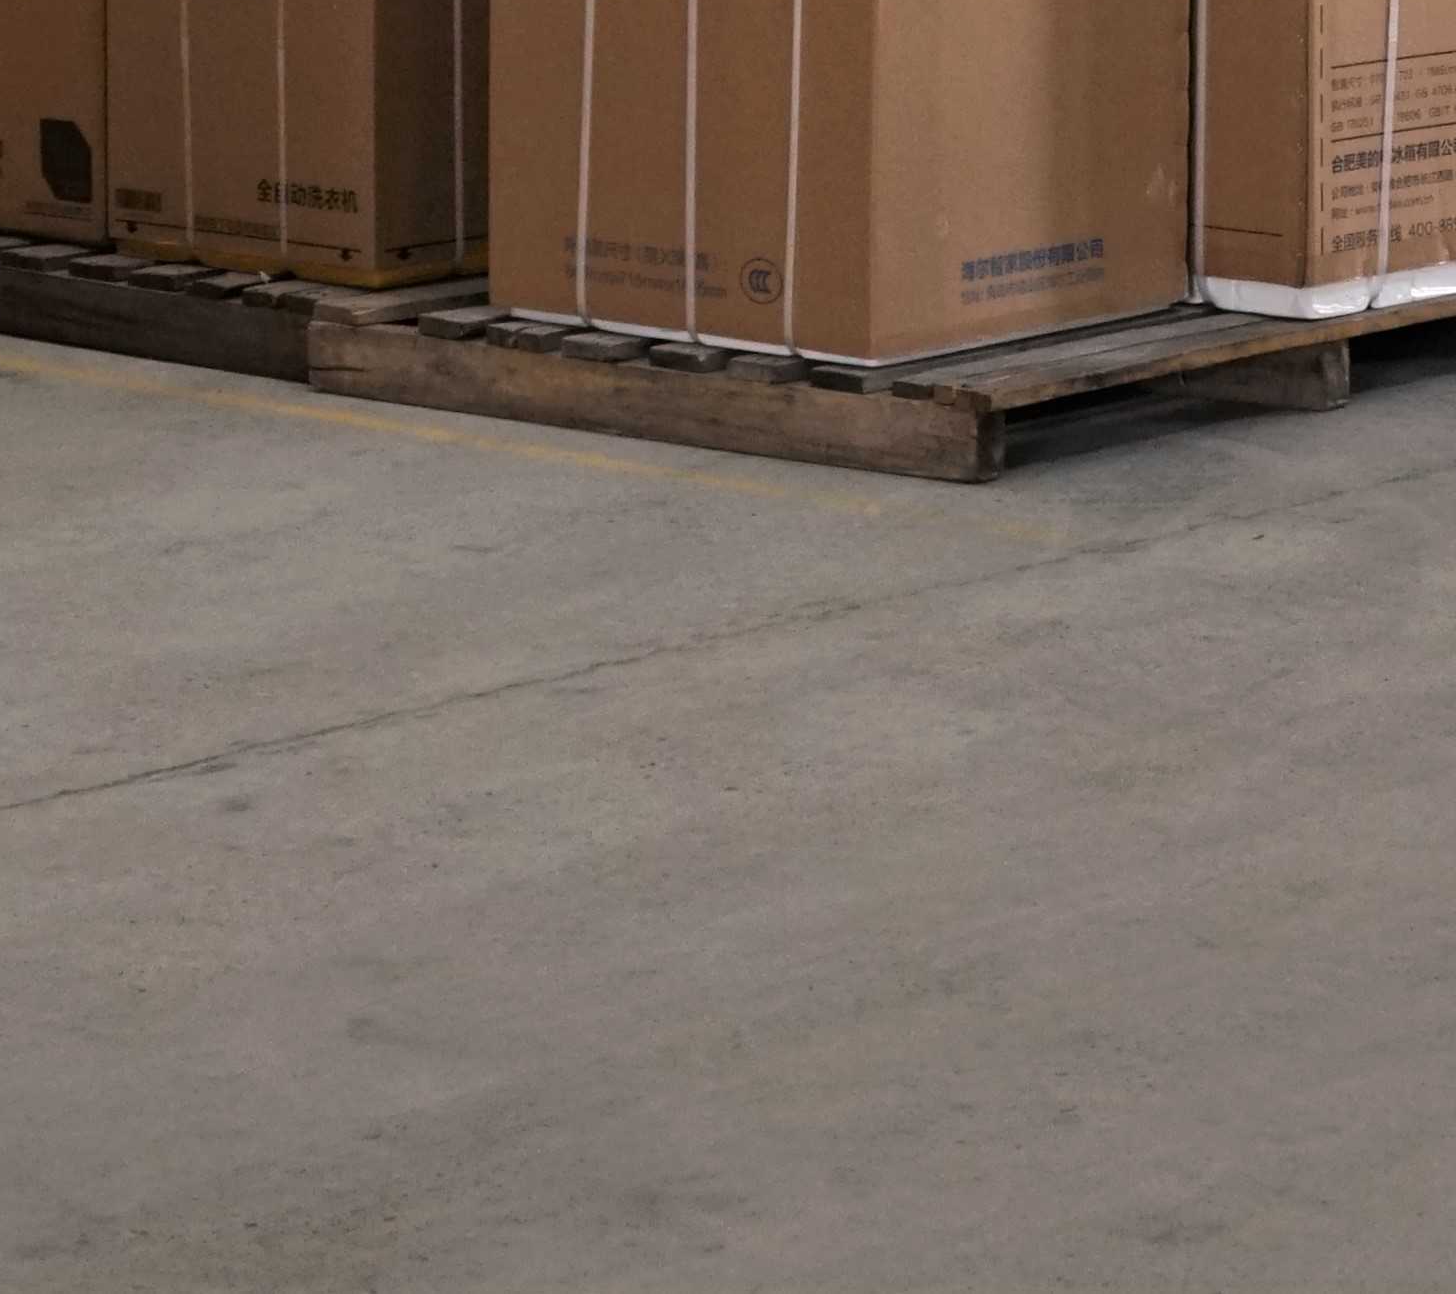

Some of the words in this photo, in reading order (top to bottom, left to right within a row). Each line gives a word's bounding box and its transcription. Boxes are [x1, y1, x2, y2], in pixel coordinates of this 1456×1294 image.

[1332, 225, 1402, 254] 全国服务线
